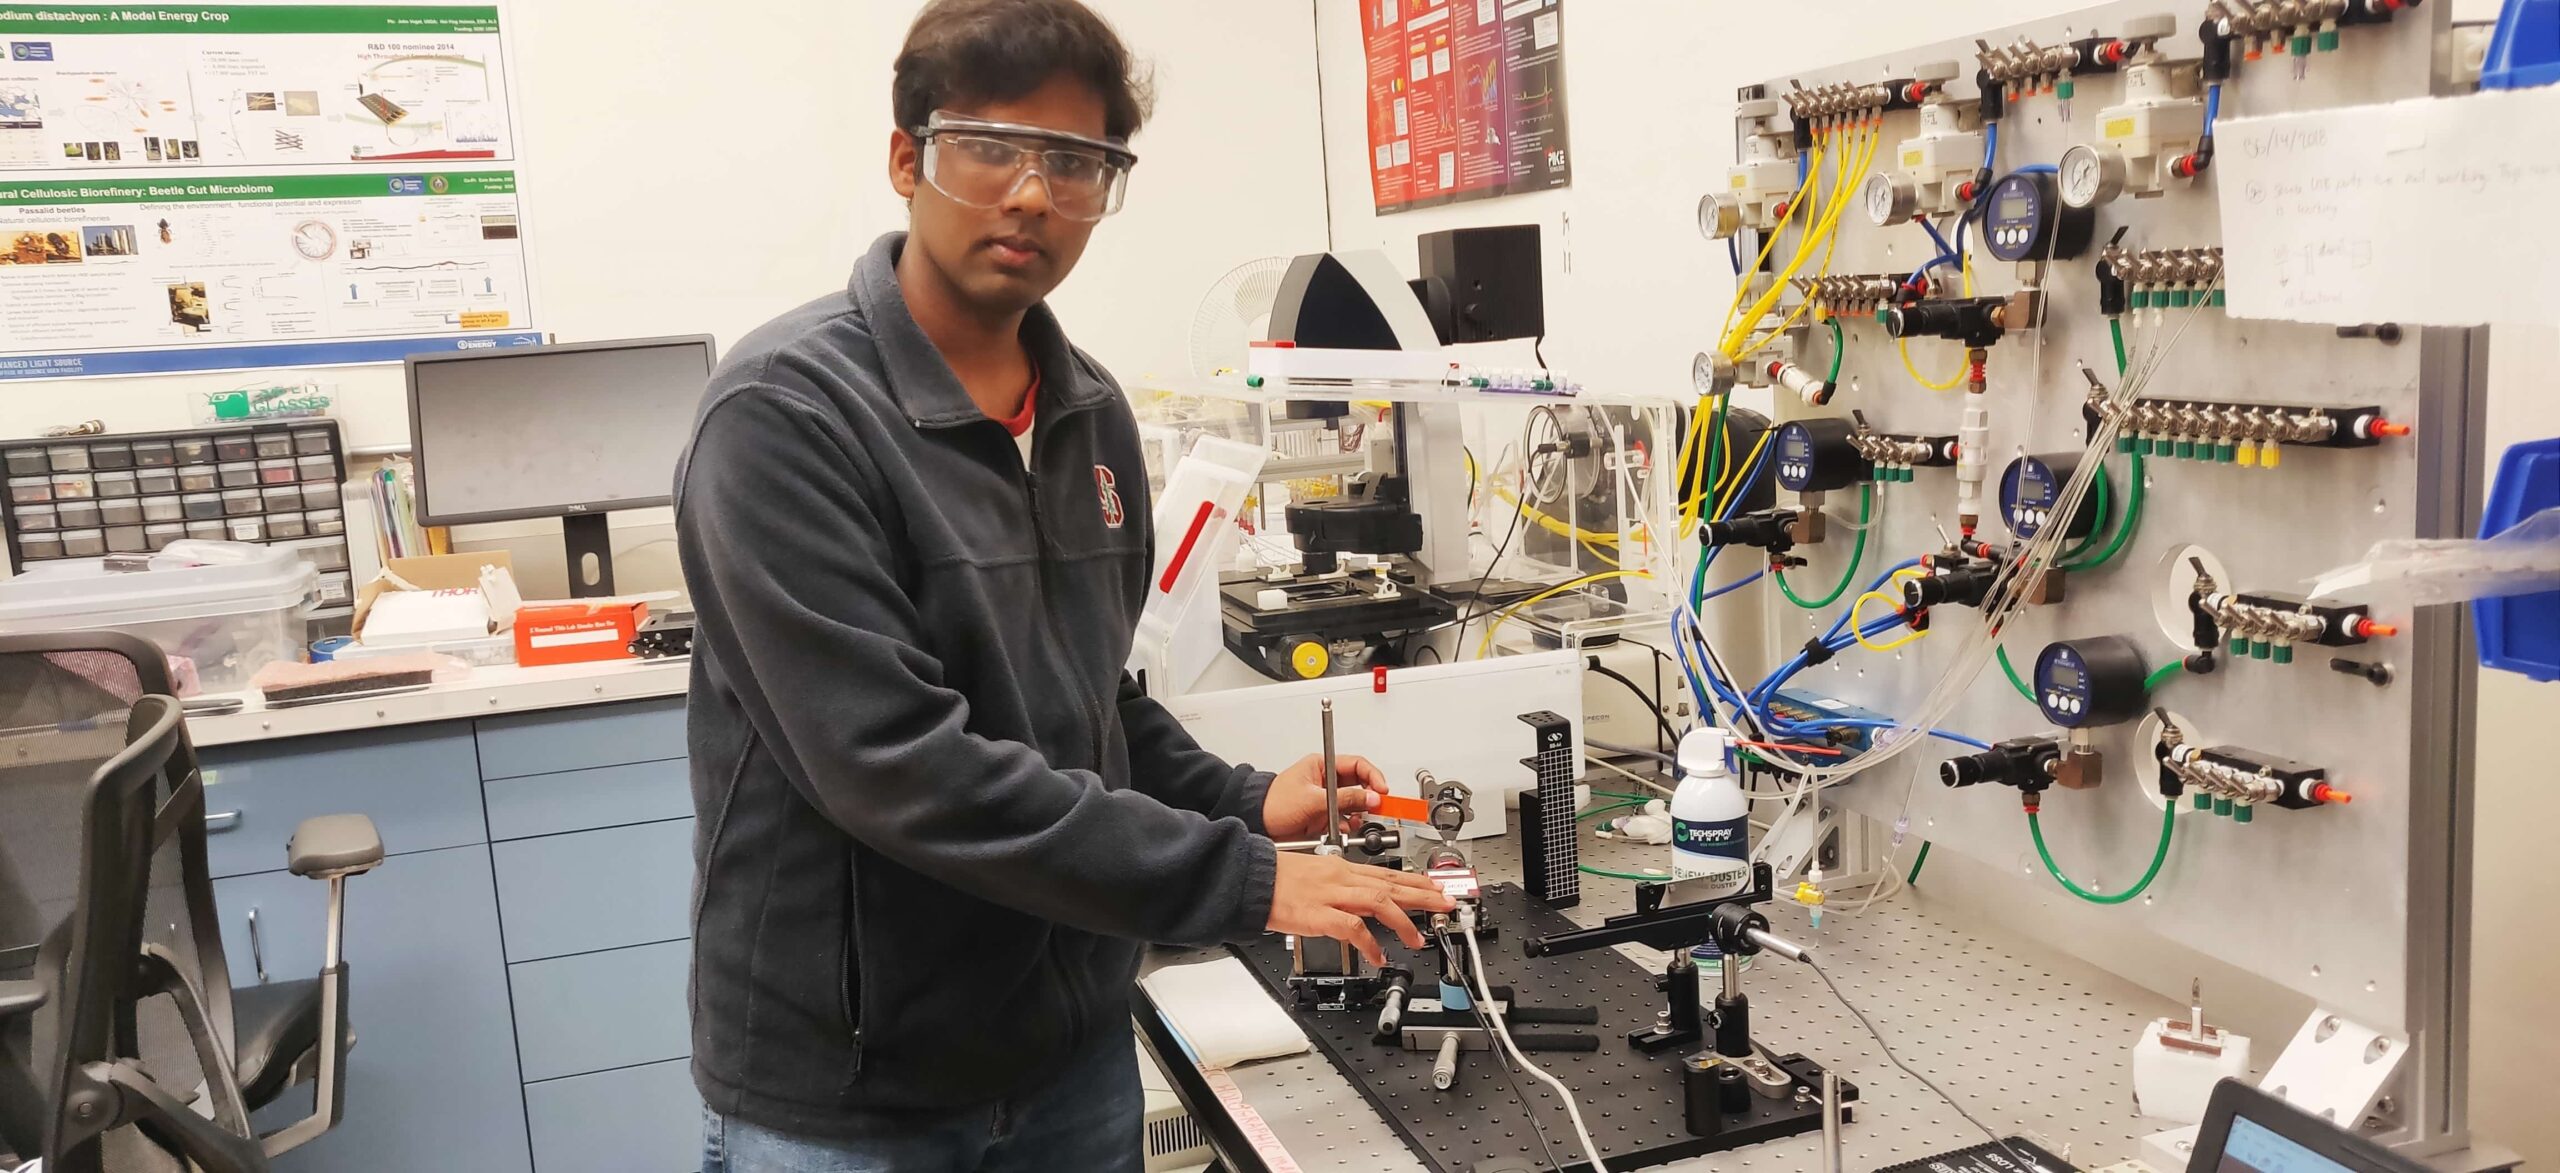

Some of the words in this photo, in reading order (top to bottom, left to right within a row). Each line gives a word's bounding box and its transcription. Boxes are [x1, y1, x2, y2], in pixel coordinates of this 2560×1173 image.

[36, 11, 101, 23] distachyon
[110, 12, 120, 21] A
[122, 11, 156, 21] Model
[160, 11, 198, 23] Energy
[201, 12, 230, 22] Crop
[368, 43, 386, 51] R&D
[388, 43, 401, 51] 100
[403, 43, 435, 51] nominee
[437, 43, 455, 51] 2014
[20, 188, 79, 199] Cellulosic
[80, 186, 147, 198] Biorefinery:
[149, 186, 184, 196] Beetle
[187, 185, 207, 195] Gut
[209, 184, 274, 195] Microbiome
[140, 203, 171, 211] Defining
[275, 200, 305, 208] potential
[323, 199, 362, 207] expression
[19, 207, 55, 215] Passalid
[27, 215, 62, 224] cellulosic
[54, 358, 83, 367] SOURCE
[253, 396, 331, 412] GLASSES
[1689, 828, 1733, 838] TECHSPRAY
[1711, 881, 1737, 889] DUSTER
